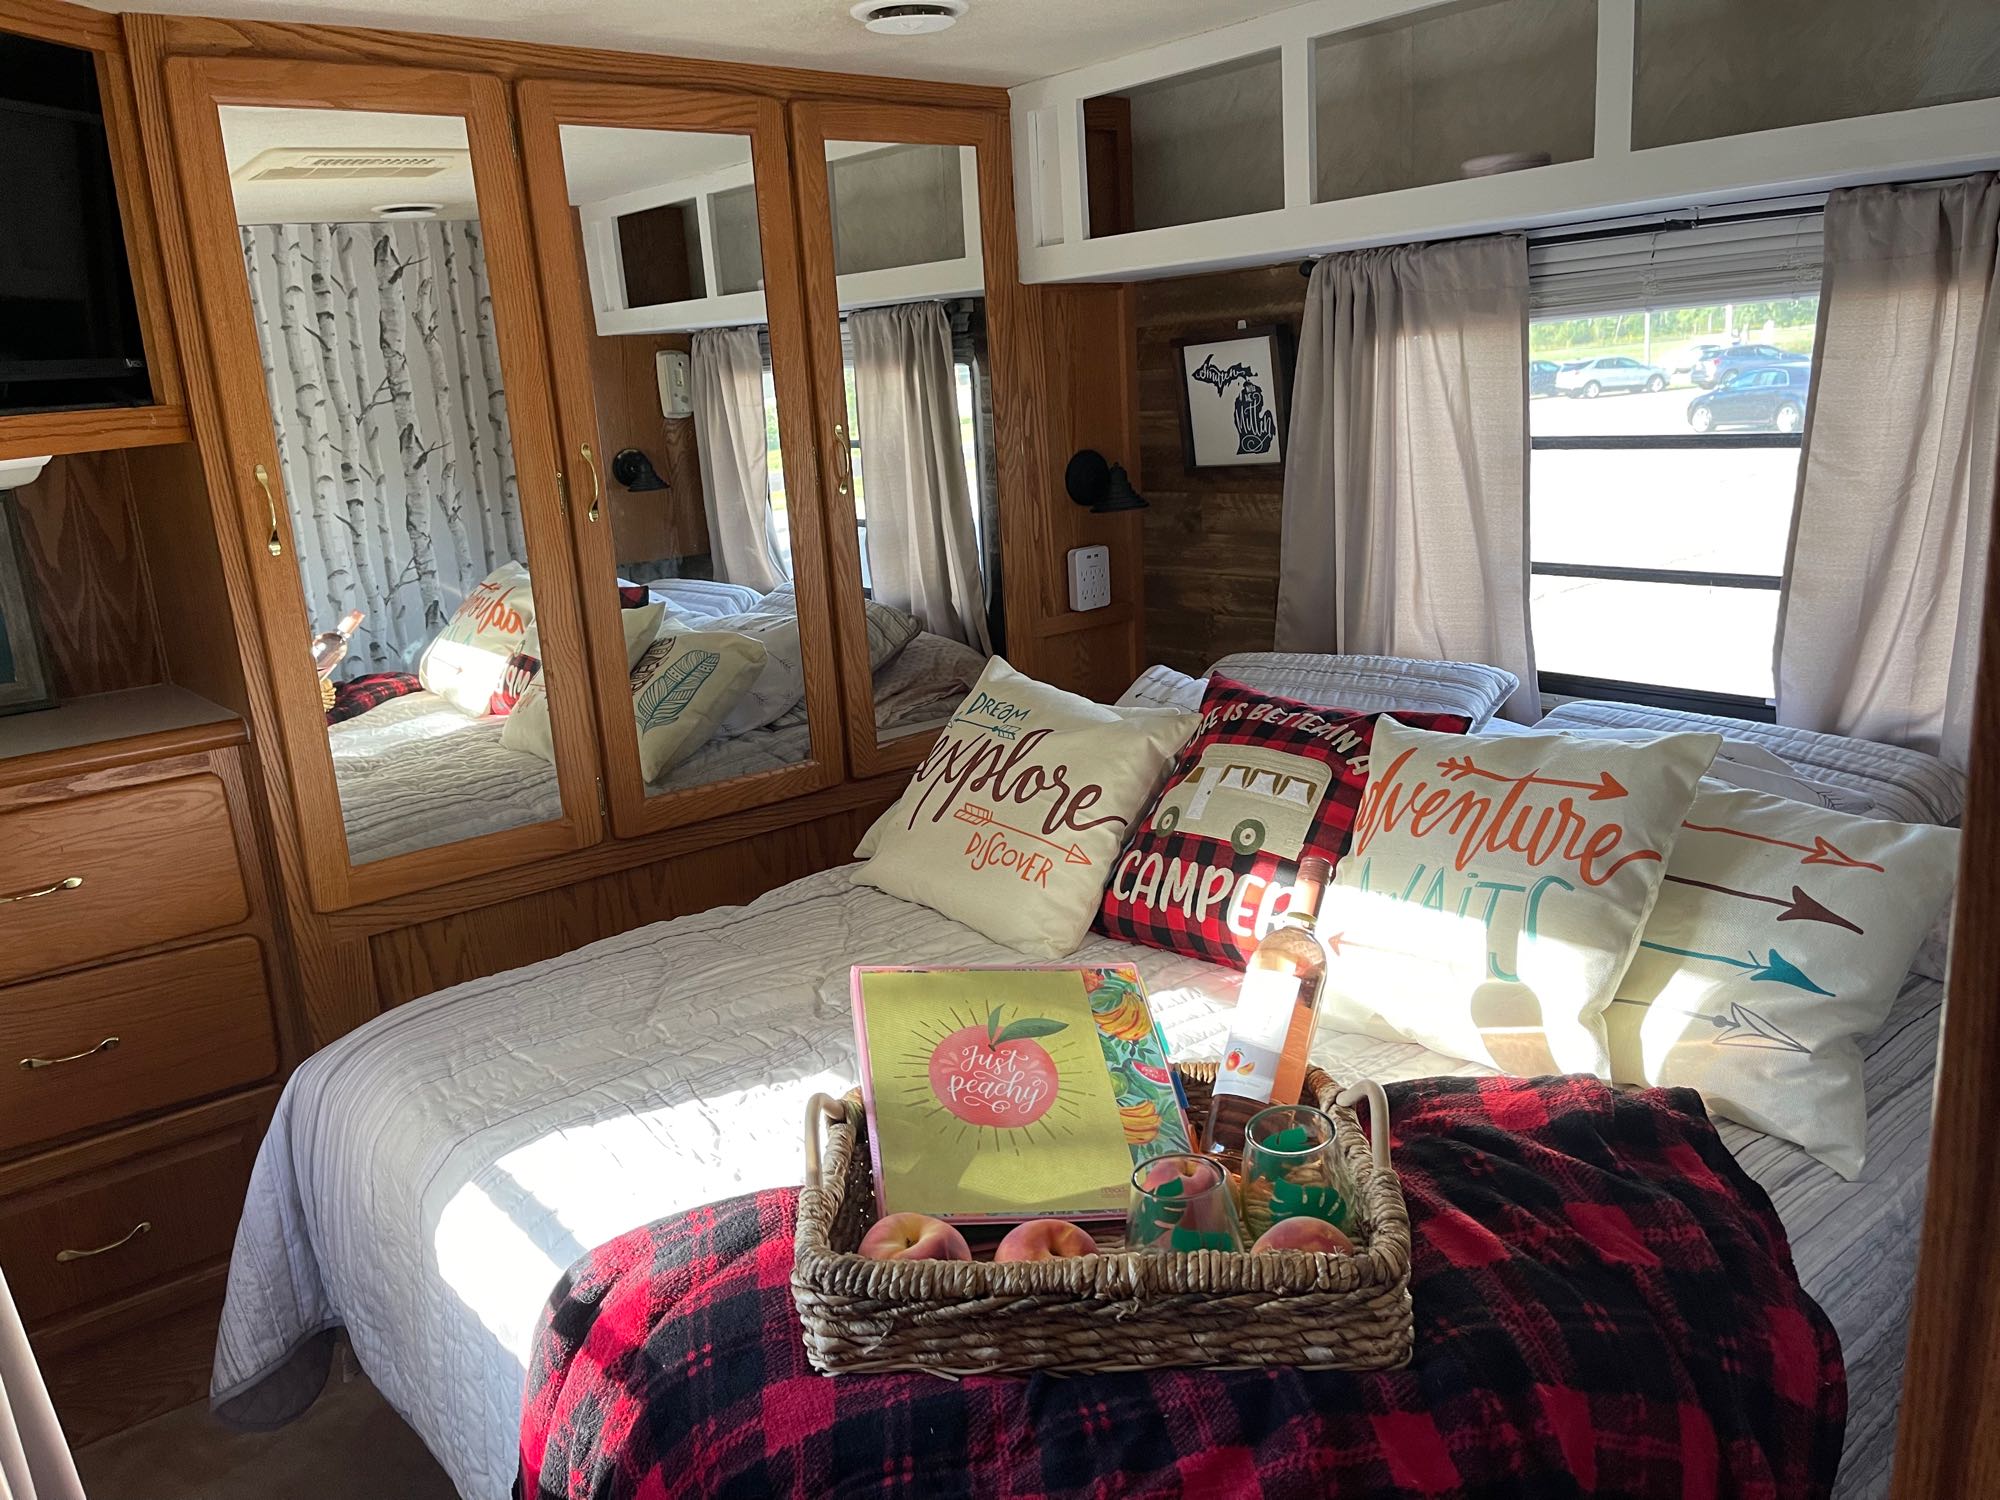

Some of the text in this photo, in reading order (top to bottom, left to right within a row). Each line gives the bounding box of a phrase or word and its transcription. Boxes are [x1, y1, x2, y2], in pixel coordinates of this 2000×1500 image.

[967, 691, 1031, 722] DREAM
[1223, 702, 1249, 722] IS
[1324, 724, 1362, 753] IN
[1346, 755, 1370, 776] A
[908, 729, 1128, 835] explore
[964, 832, 1053, 889] DISCOVER
[1113, 849, 1297, 941] CAMPER
[961, 1045, 1029, 1074] Just
[947, 1071, 1048, 1114] peachy
